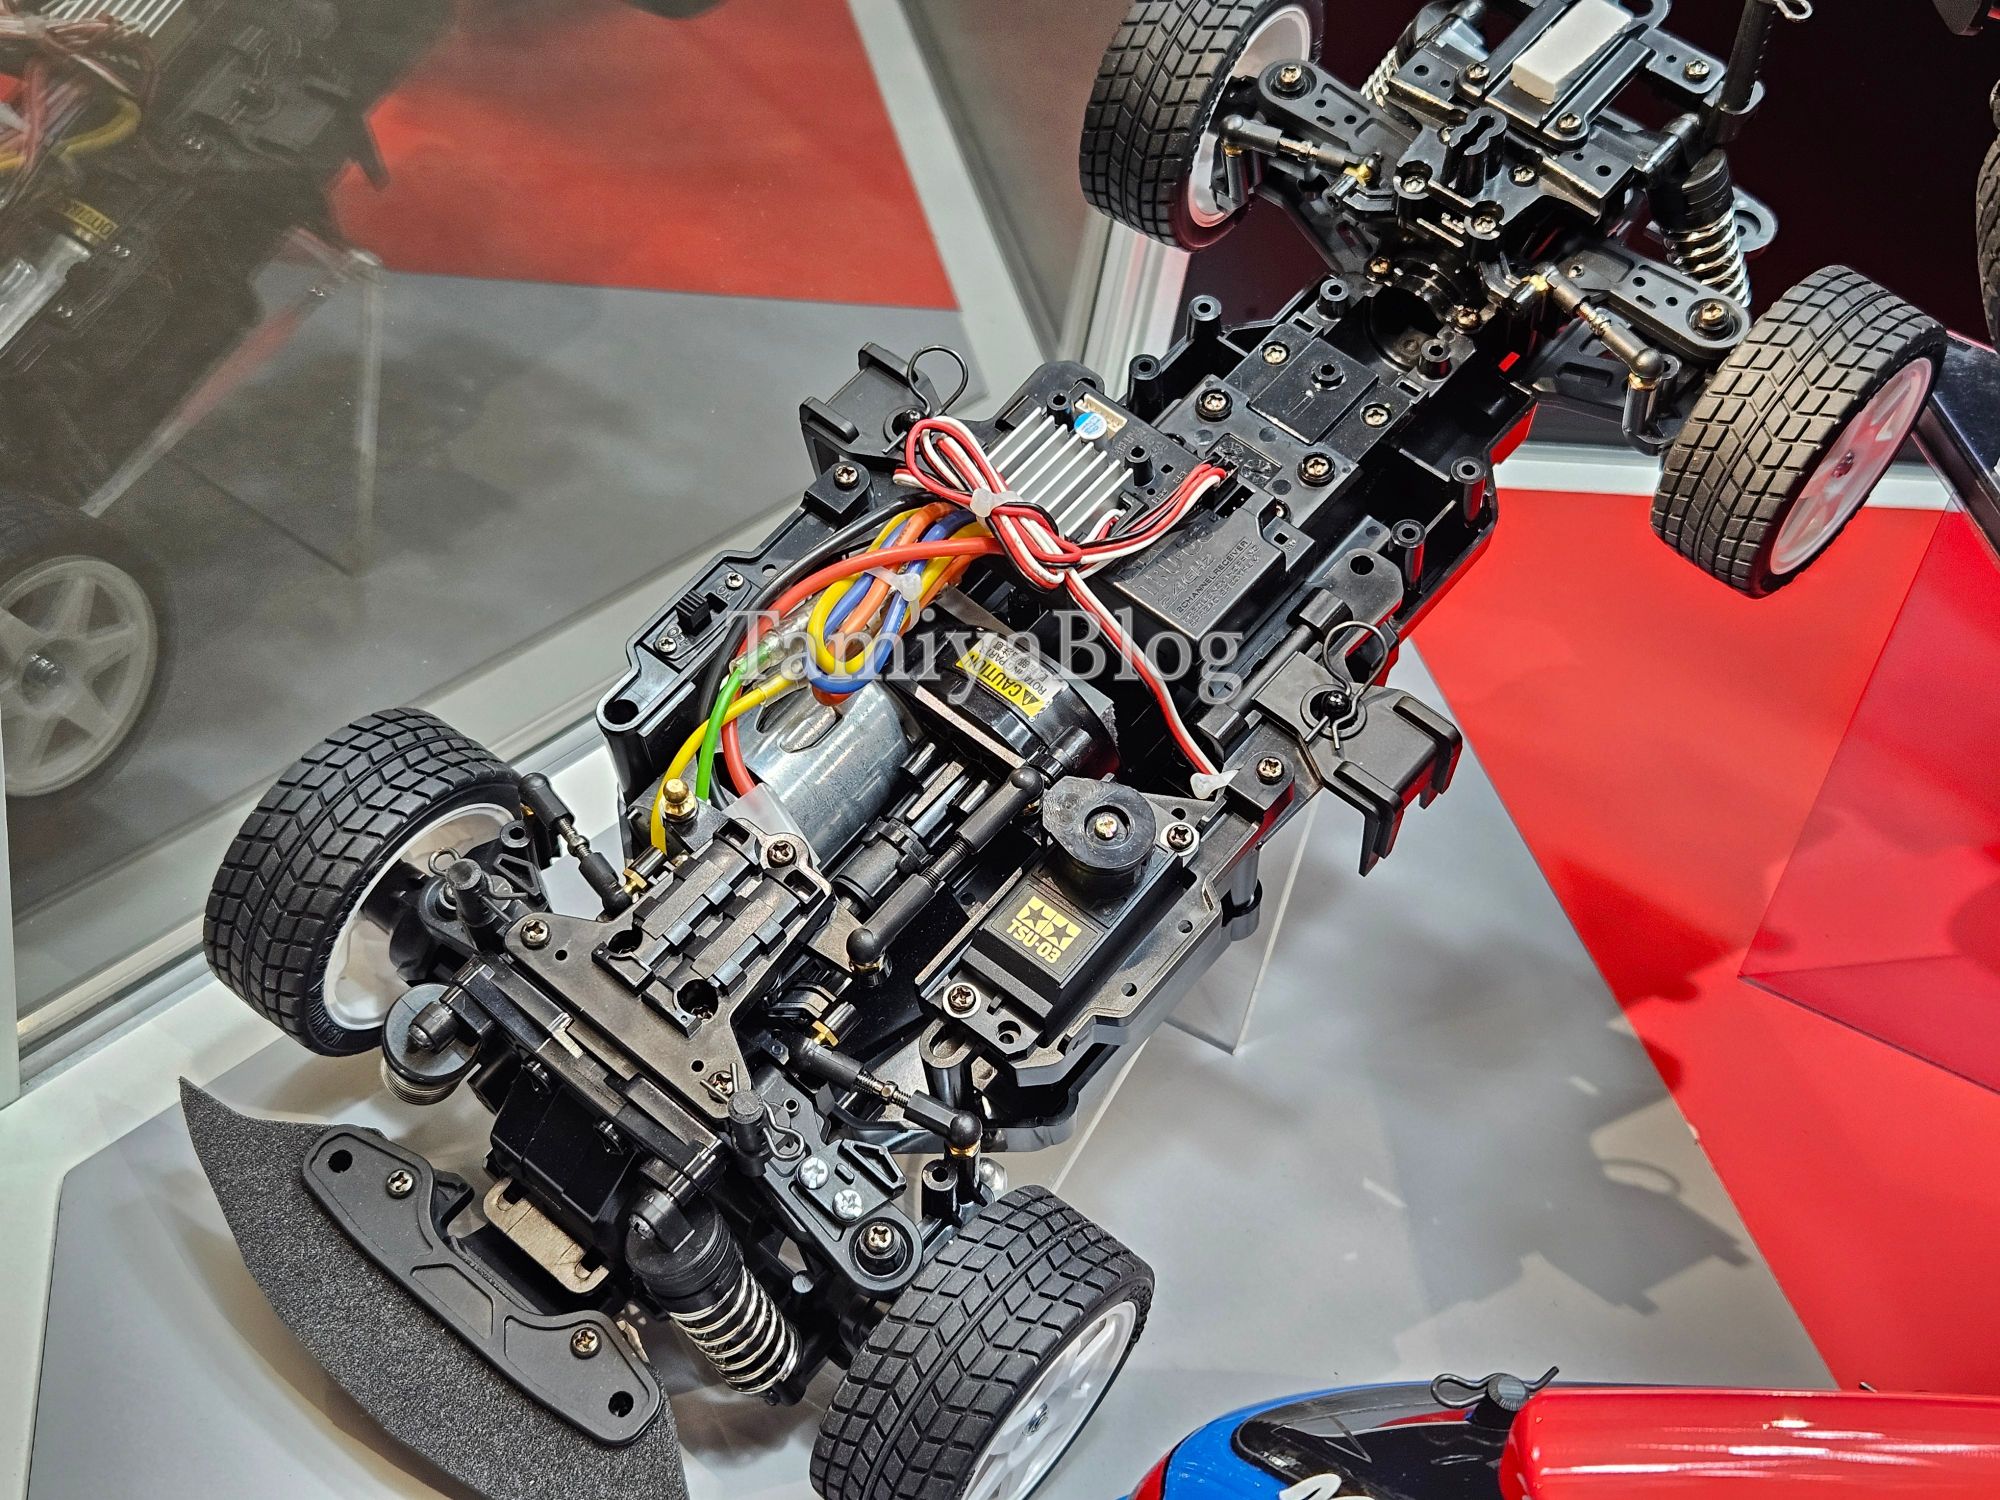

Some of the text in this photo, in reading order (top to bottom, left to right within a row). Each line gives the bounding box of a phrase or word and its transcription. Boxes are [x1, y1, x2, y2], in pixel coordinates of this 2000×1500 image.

[1213, 539, 1249, 576] RECEIVER
[716, 585, 736, 601] ON
[968, 654, 1023, 698] CAUTION
